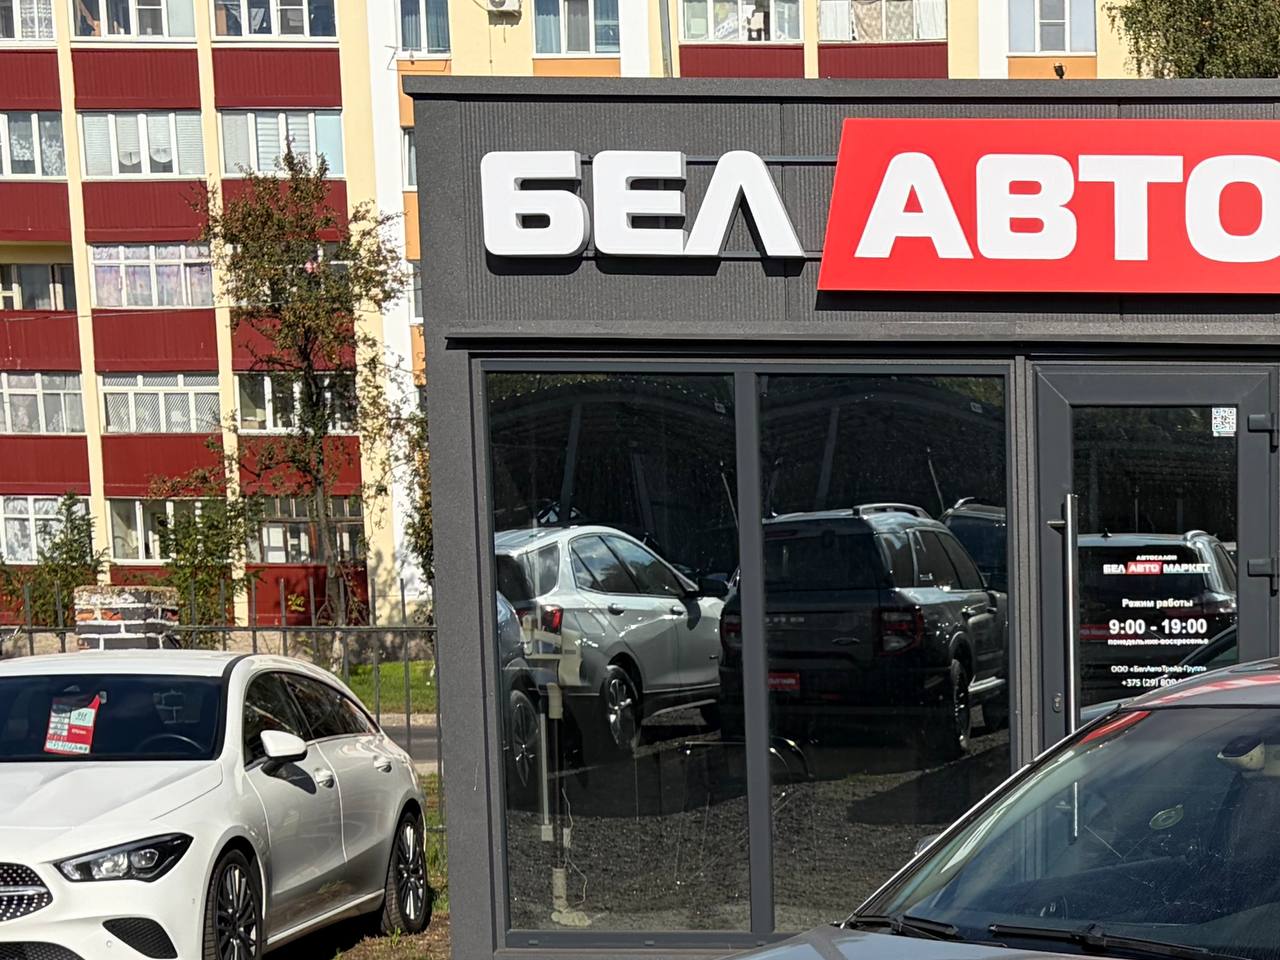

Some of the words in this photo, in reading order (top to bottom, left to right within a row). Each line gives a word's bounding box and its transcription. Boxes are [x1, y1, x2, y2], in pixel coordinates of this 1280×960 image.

[480, 149, 804, 257] БЕЛ
[1103, 564, 1126, 575] БЕЛ
[1128, 563, 1160, 573] АВТО
[1163, 563, 1211, 574] МАРКЕТ
[1121, 598, 1155, 608] Режим
[1156, 598, 1193, 610] работы
[1108, 618, 1146, 635] 9:00
[1161, 618, 1208, 635] 19:00
[1110, 665, 1129, 673] ООО
[1121, 678, 1141, 687] +375
[1142, 677, 1159, 688] (29)
